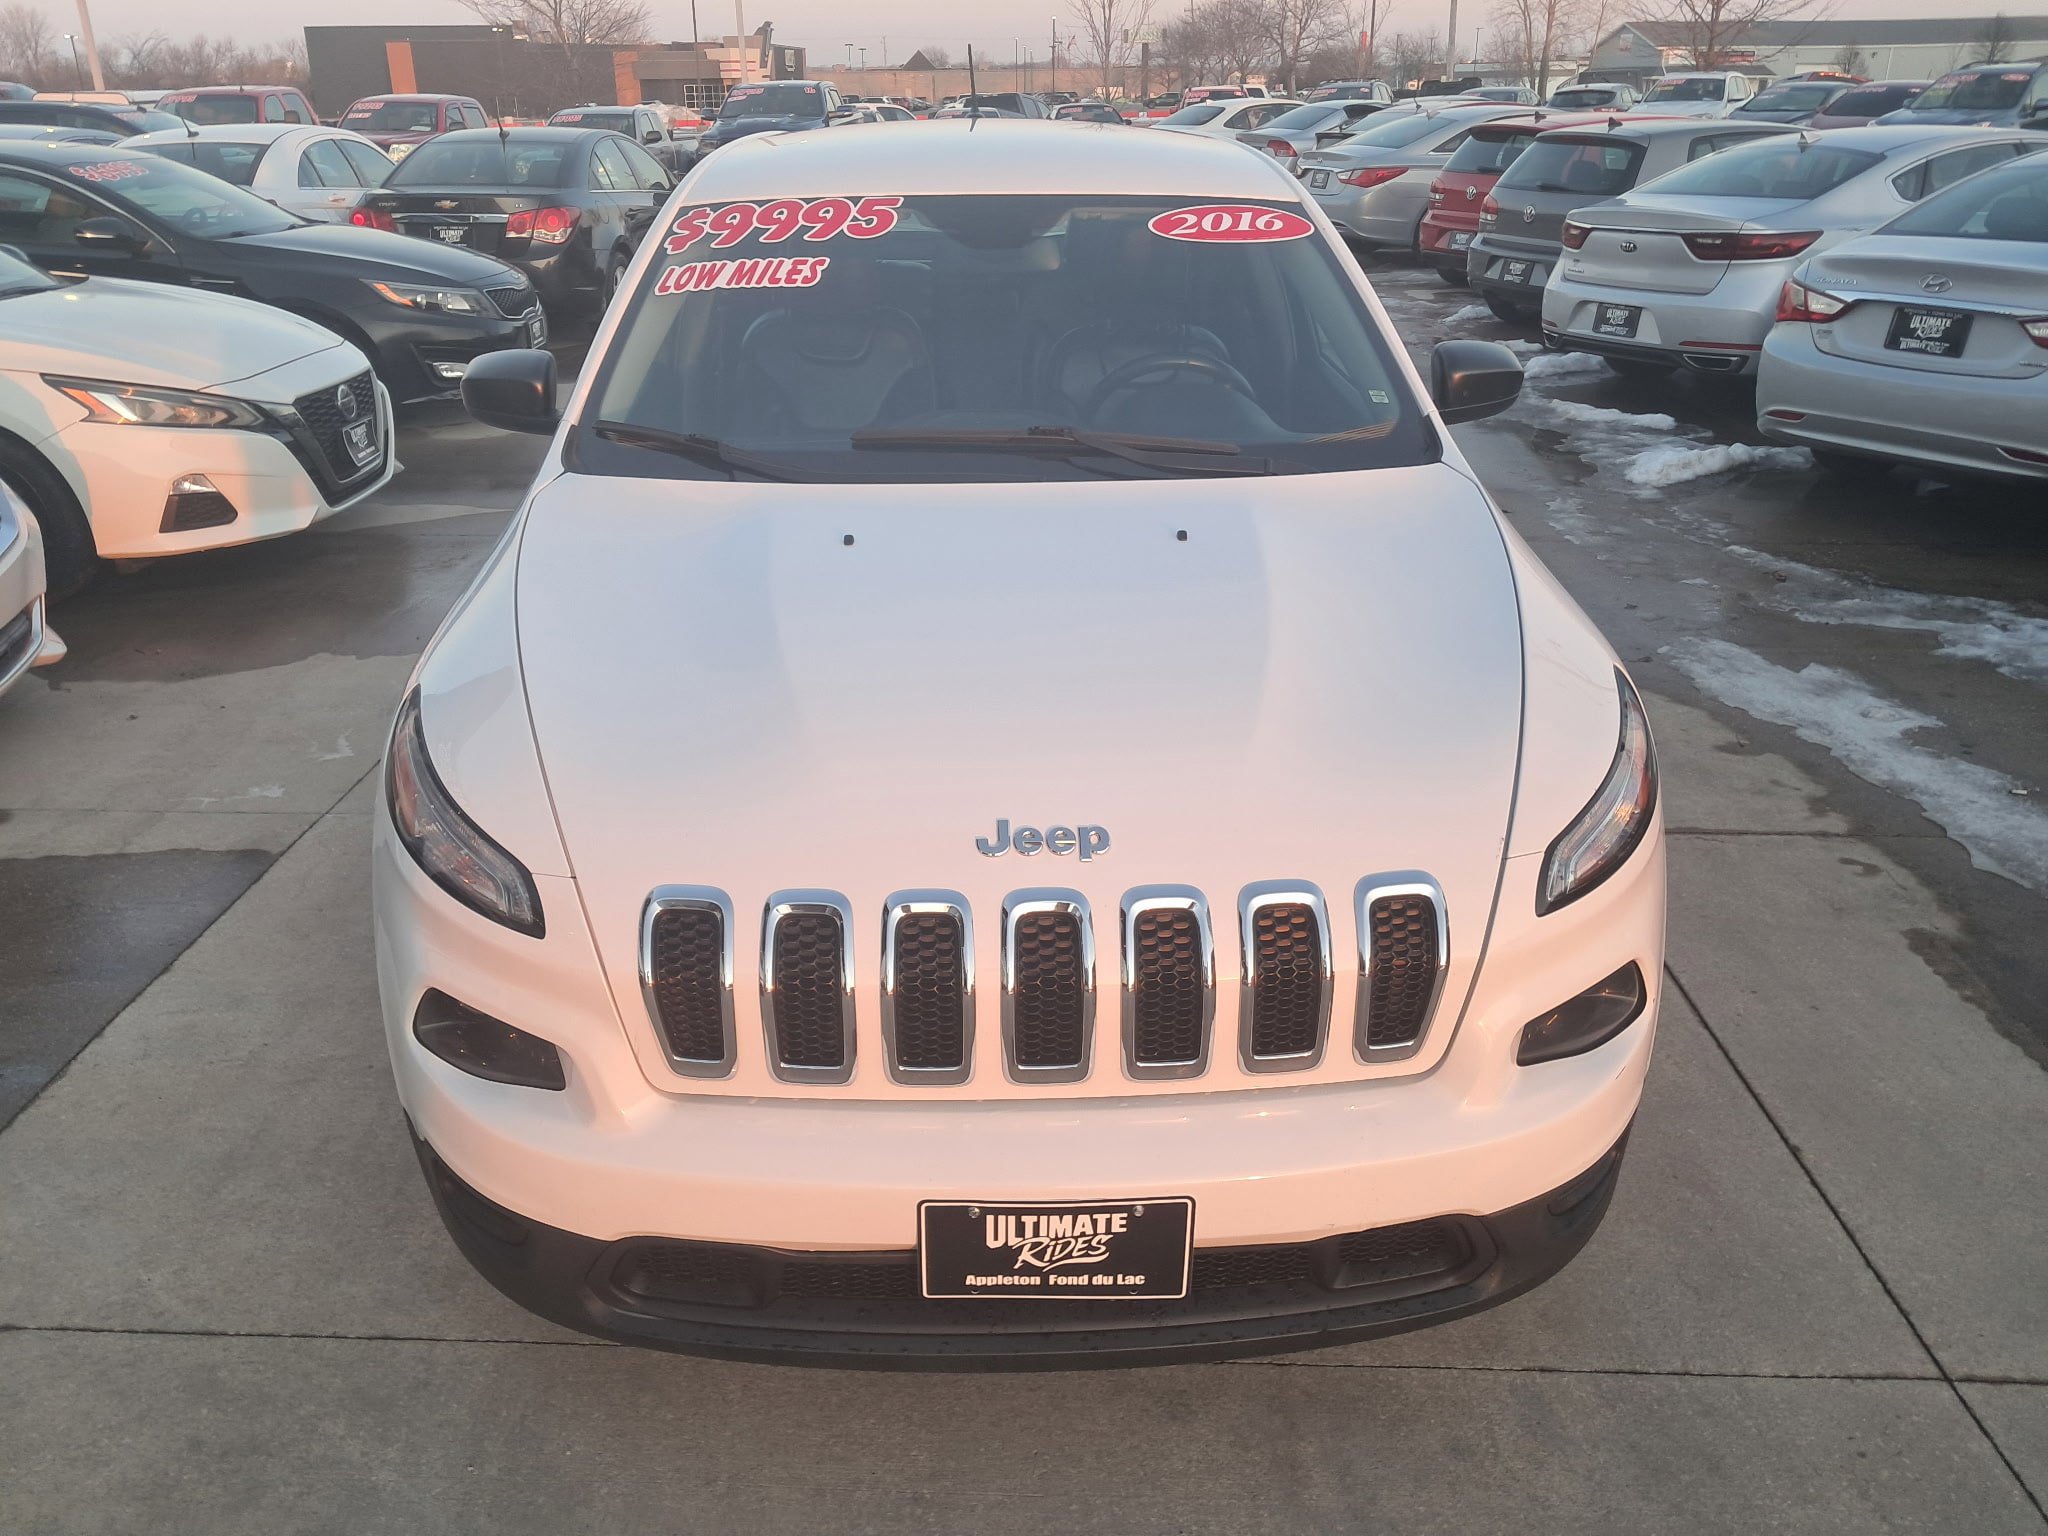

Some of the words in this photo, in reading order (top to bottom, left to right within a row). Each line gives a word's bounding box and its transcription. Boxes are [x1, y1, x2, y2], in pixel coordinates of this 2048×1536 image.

[664, 196, 904, 254] $9995
[1168, 212, 1284, 235] 2016
[655, 262, 728, 295] LOW
[725, 257, 830, 288] MILES
[1910, 315, 1952, 329] ULTIMATE
[976, 819, 1110, 862] Jeep
[985, 1212, 1128, 1249] ULTIMATE
[965, 1274, 1041, 1287] Appleton
[1048, 1273, 1088, 1286] Fond
[1091, 1273, 1114, 1286] du
[1116, 1273, 1146, 1286] Lac
